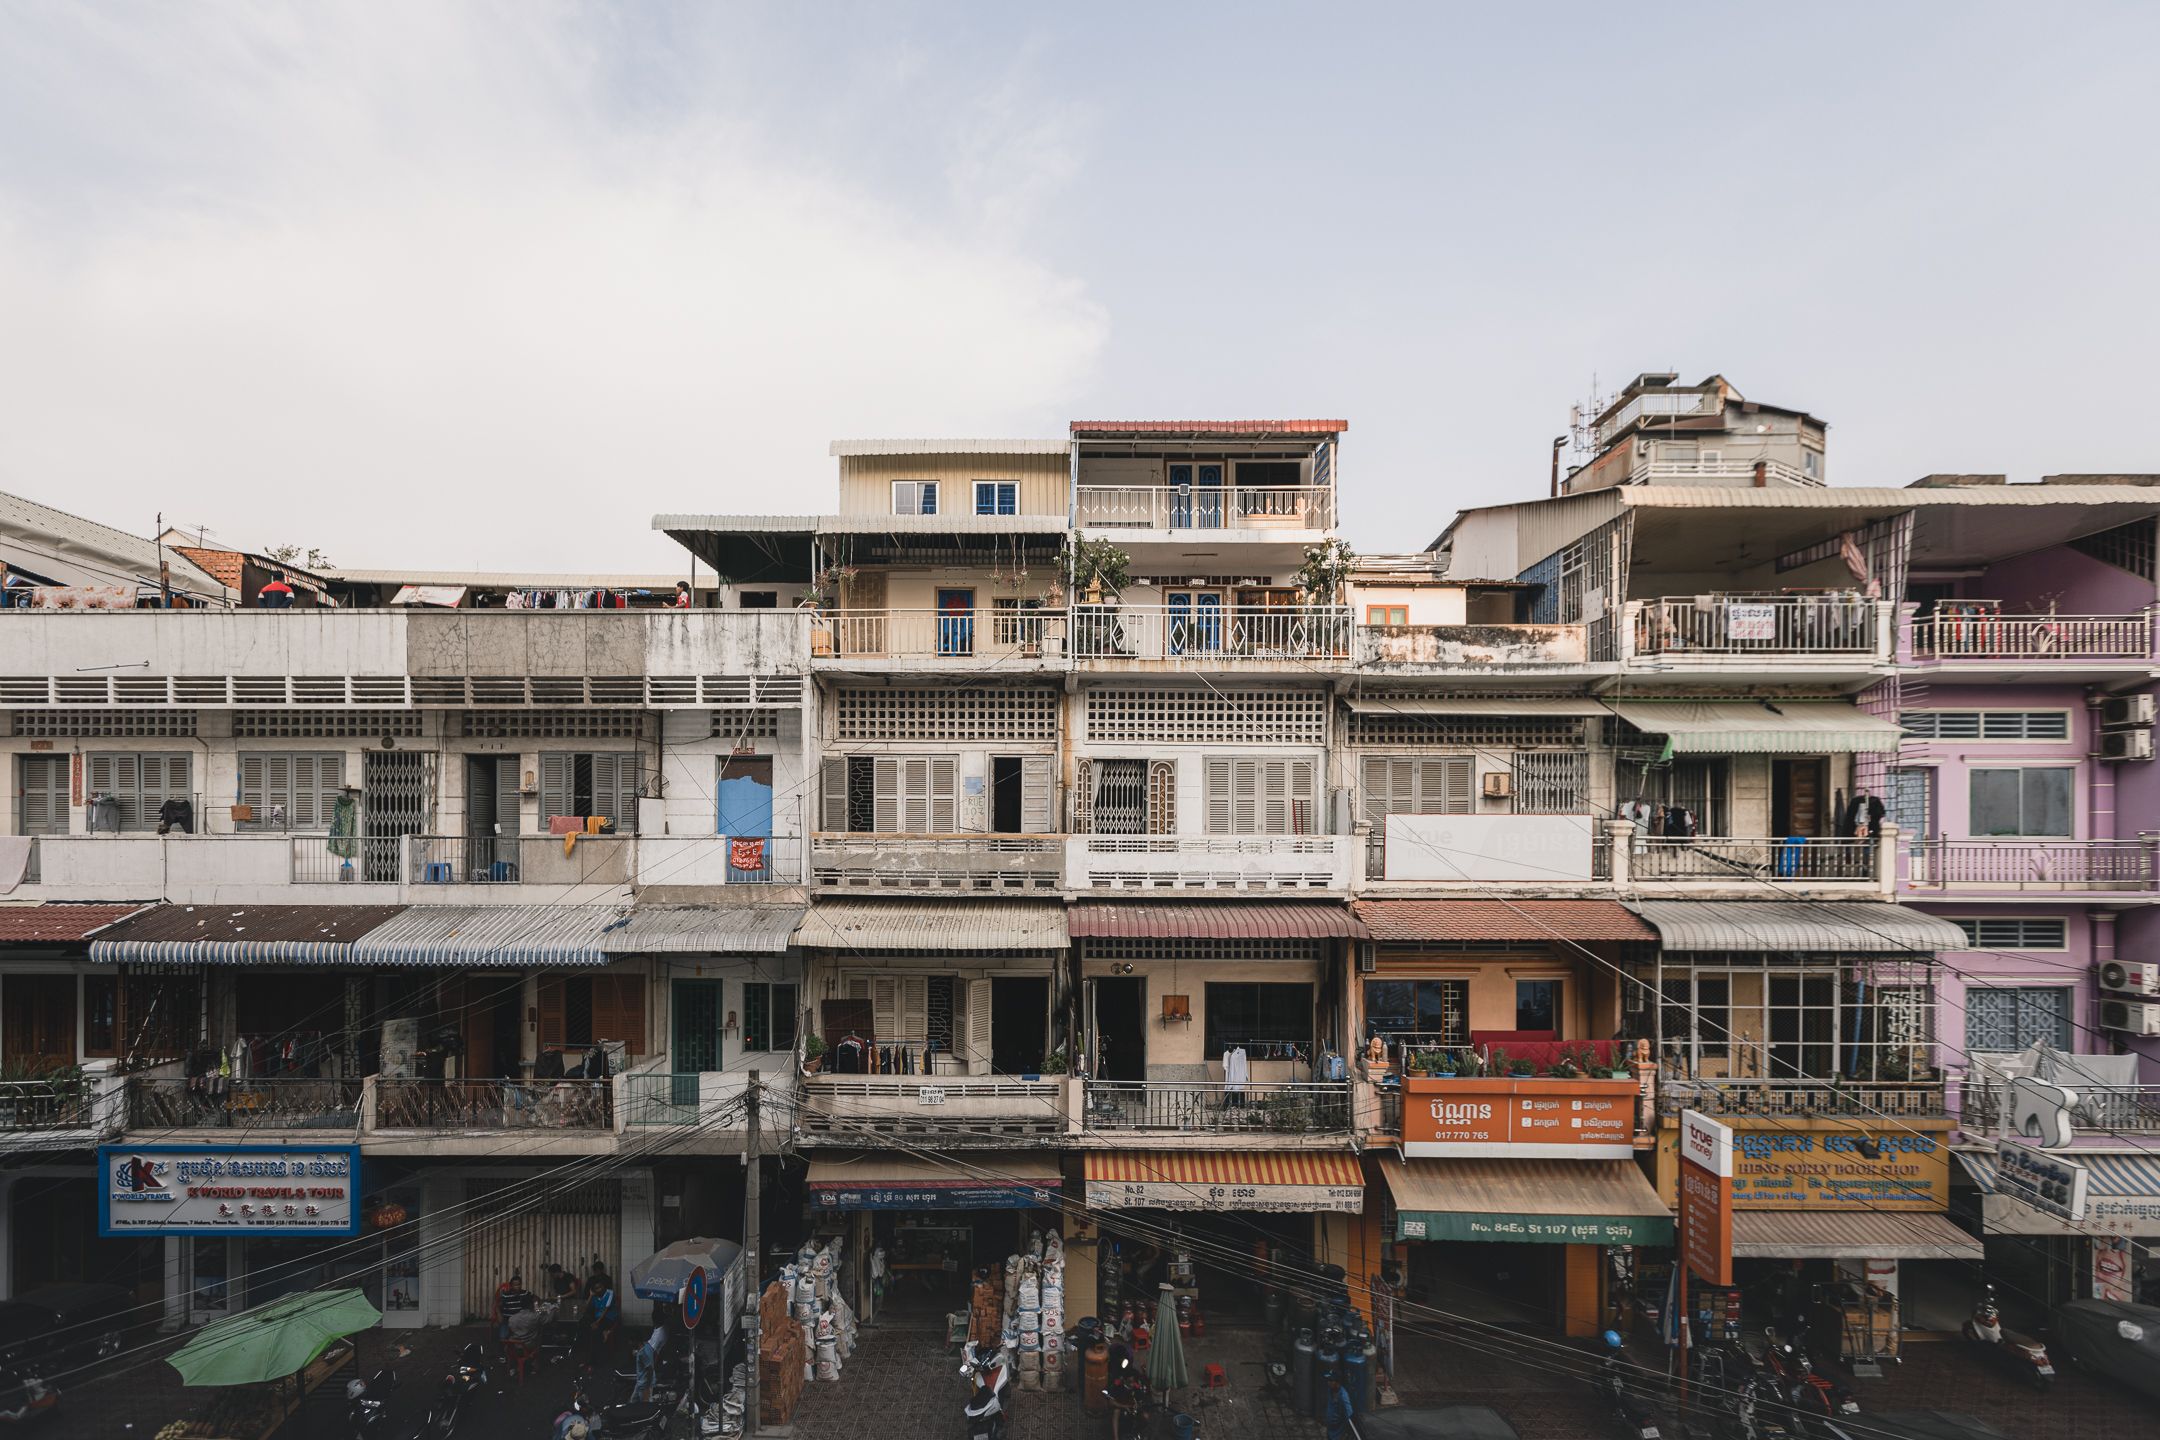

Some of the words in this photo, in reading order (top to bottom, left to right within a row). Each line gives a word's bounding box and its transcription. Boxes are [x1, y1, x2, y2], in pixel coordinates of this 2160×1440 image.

[1435, 1131, 1451, 1139] 017
[1453, 1131, 1470, 1139] 770
[1472, 1131, 1489, 1139] 765
[1689, 1123, 1713, 1147] true
[1690, 1140, 1713, 1160] money
[1739, 1163, 1780, 1174] HENG
[1834, 1164, 1876, 1175] BOOK
[1881, 1164, 1920, 1175] SHOP
[199, 1187, 246, 1199] WORLD
[248, 1187, 294, 1199] TRAVEL
[307, 1187, 344, 1200] TOUR
[1125, 1185, 1135, 1194] No.
[1136, 1186, 1144, 1194] 82
[1471, 1223, 1491, 1232] No.
[1527, 1224, 1542, 1234] St
[1545, 1224, 1567, 1234] 107
[646, 1275, 676, 1287] pepsi
